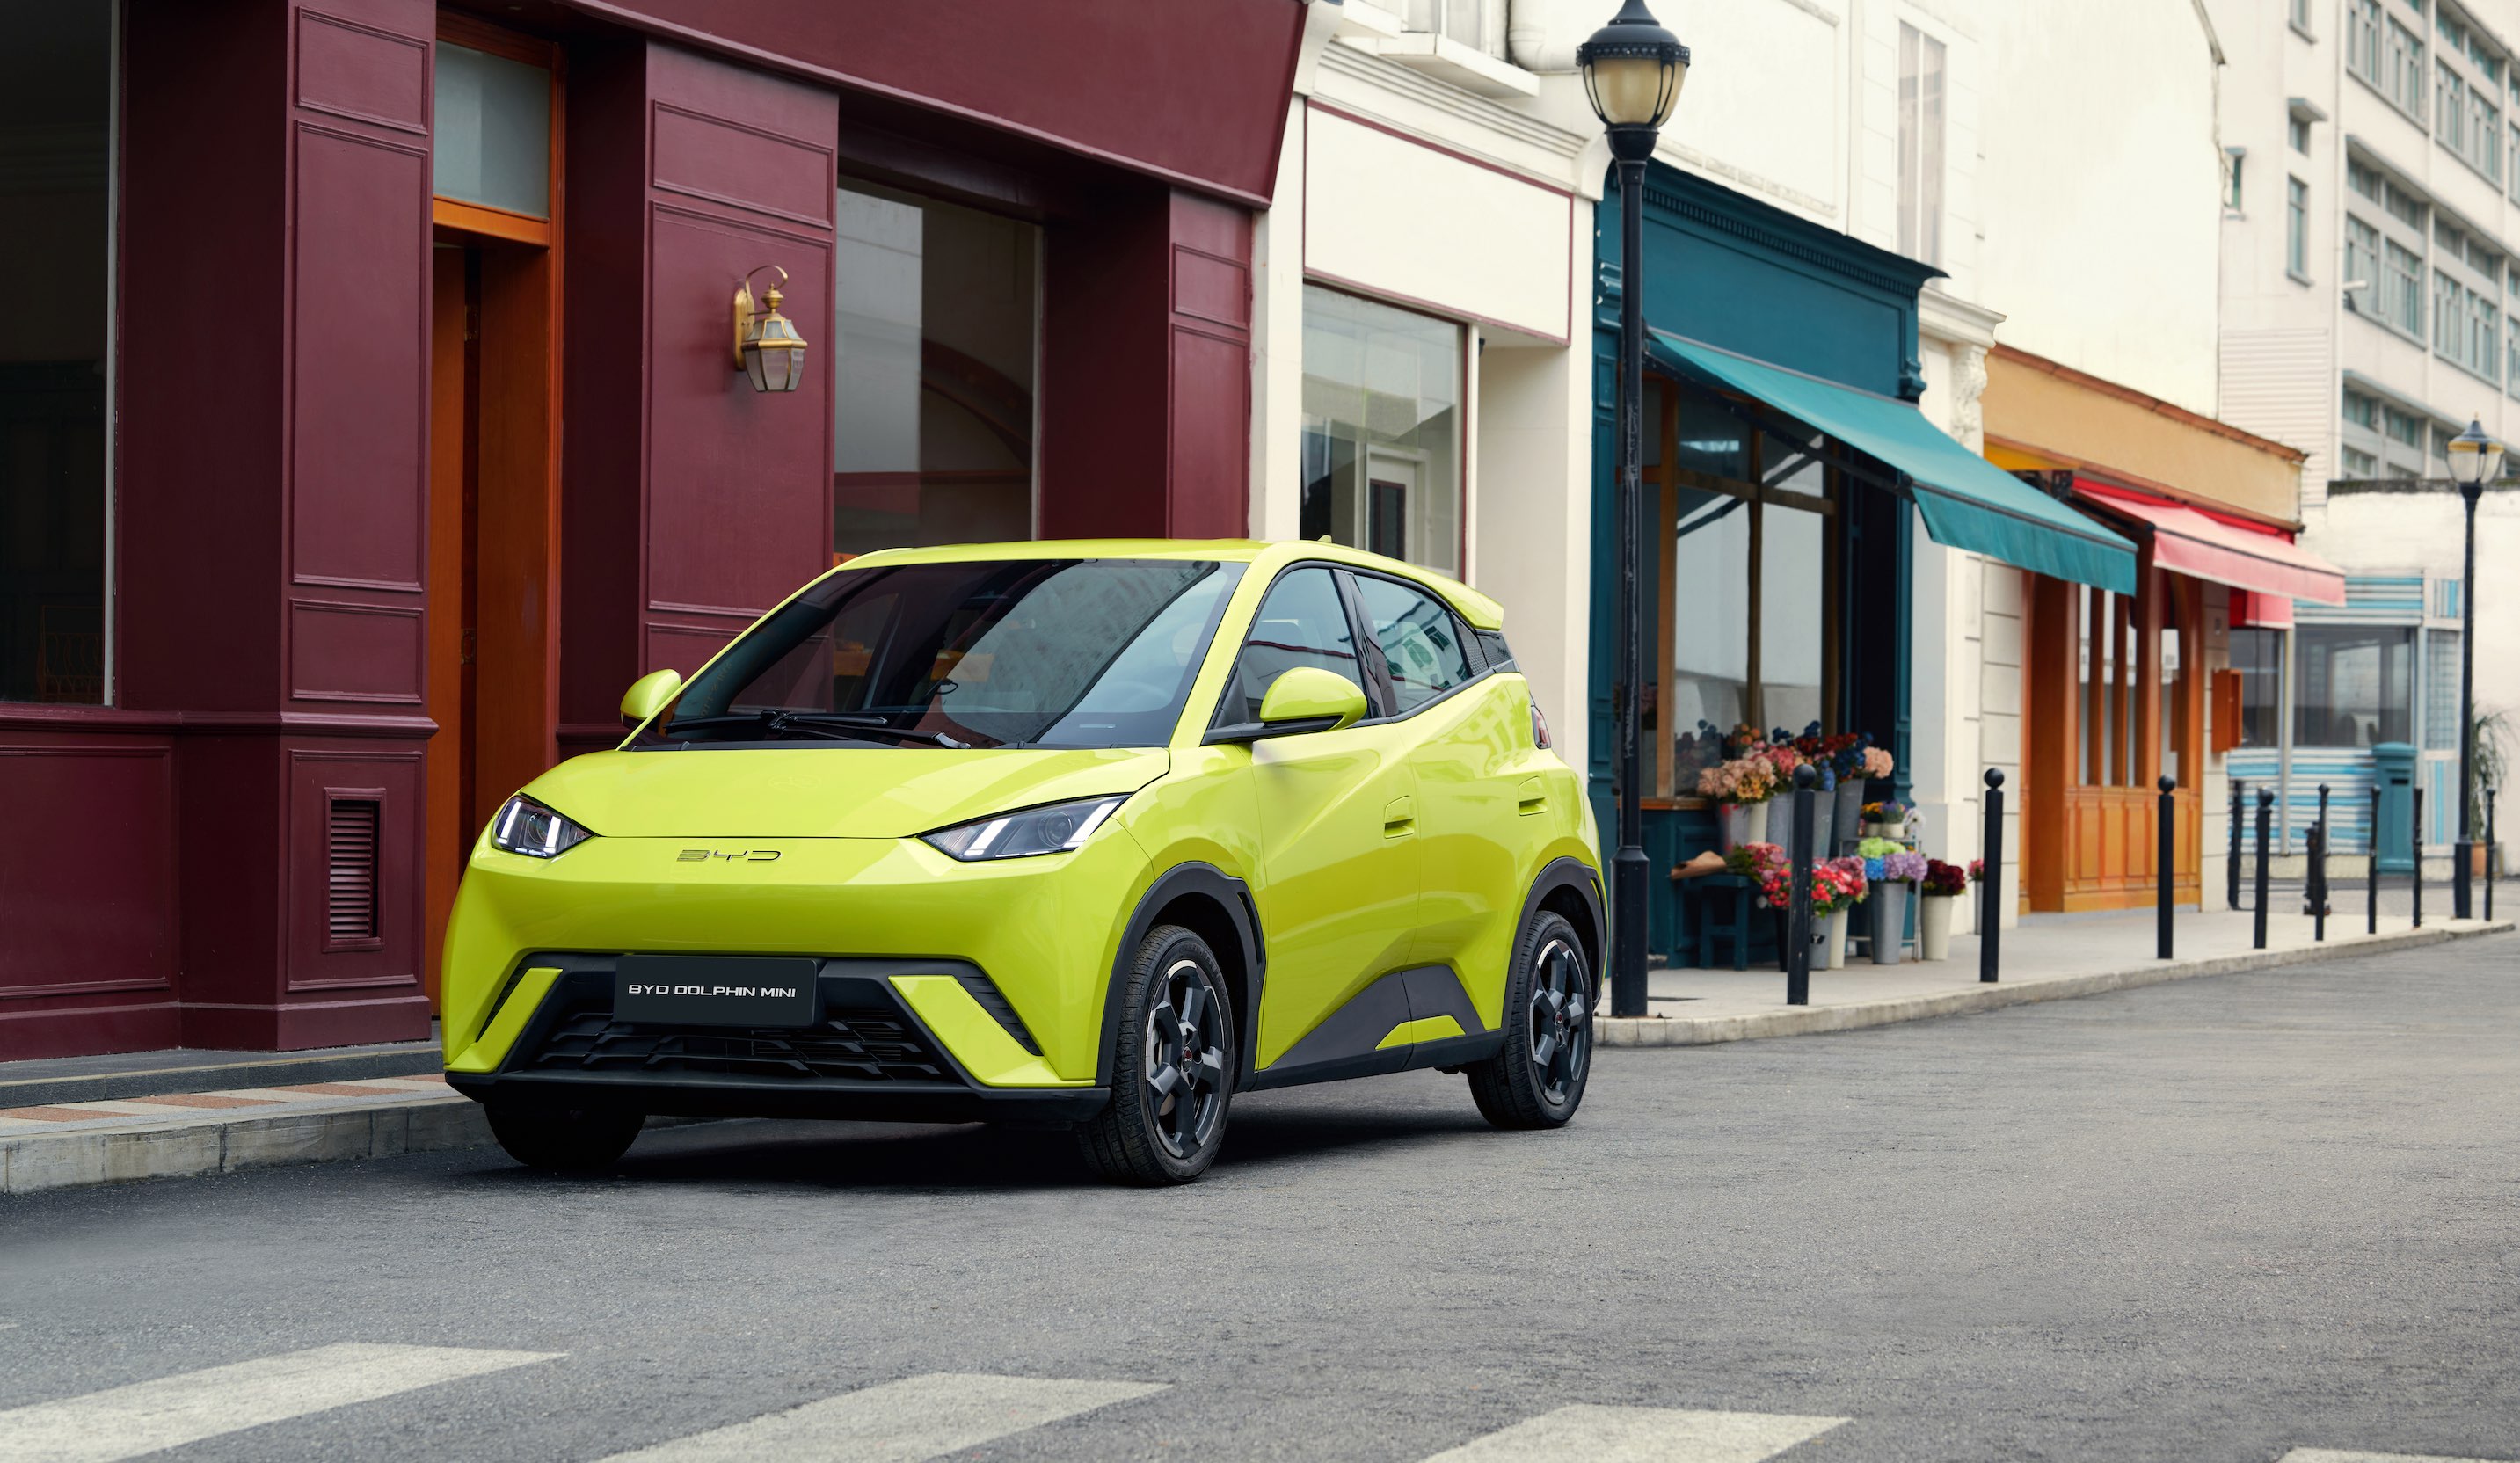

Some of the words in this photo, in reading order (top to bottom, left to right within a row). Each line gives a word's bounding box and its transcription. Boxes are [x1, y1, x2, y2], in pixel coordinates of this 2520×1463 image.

[676, 849, 782, 862] BYD
[629, 985, 669, 994] BYD
[674, 986, 755, 996] DOLPHIN
[761, 988, 796, 997] MINI
